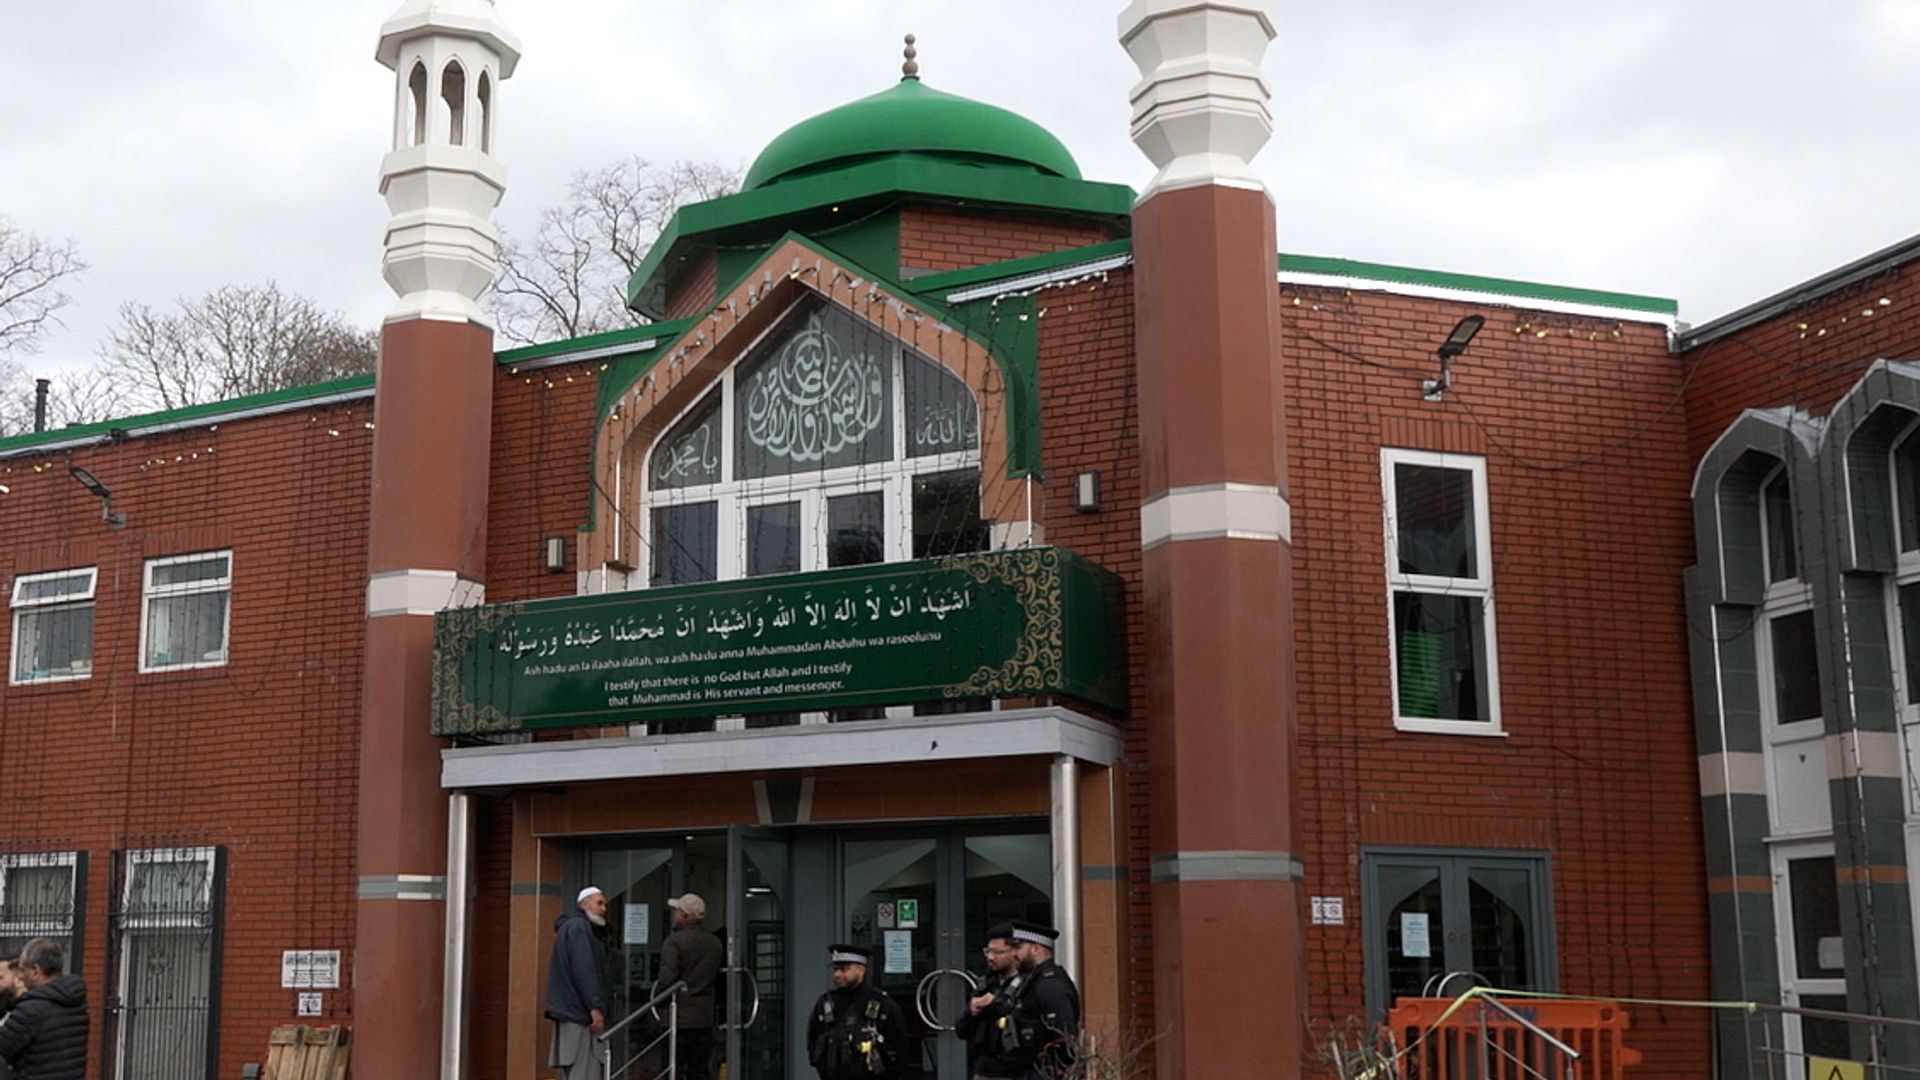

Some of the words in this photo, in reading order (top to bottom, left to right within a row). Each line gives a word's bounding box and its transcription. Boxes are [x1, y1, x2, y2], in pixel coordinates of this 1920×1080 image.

[719, 650, 744, 660] anna
[746, 641, 820, 657] Muhammadan
[823, 637, 867, 650] Abduhu
[868, 636, 884, 646] wa
[609, 679, 639, 692] testify
[641, 677, 662, 688] that
[663, 675, 689, 687] there
[690, 674, 700, 684] is
[704, 674, 718, 683] no
[719, 670, 741, 682] God
[742, 669, 760, 680] but
[762, 667, 789, 679] Allah
[791, 665, 811, 676] and
[818, 661, 852, 675] testify
[608, 694, 629, 706] that
[632, 689, 691, 704] Muhammad
[693, 689, 701, 699] is
[705, 688, 721, 699] His
[723, 686, 761, 698] servant
[762, 683, 783, 694] and
